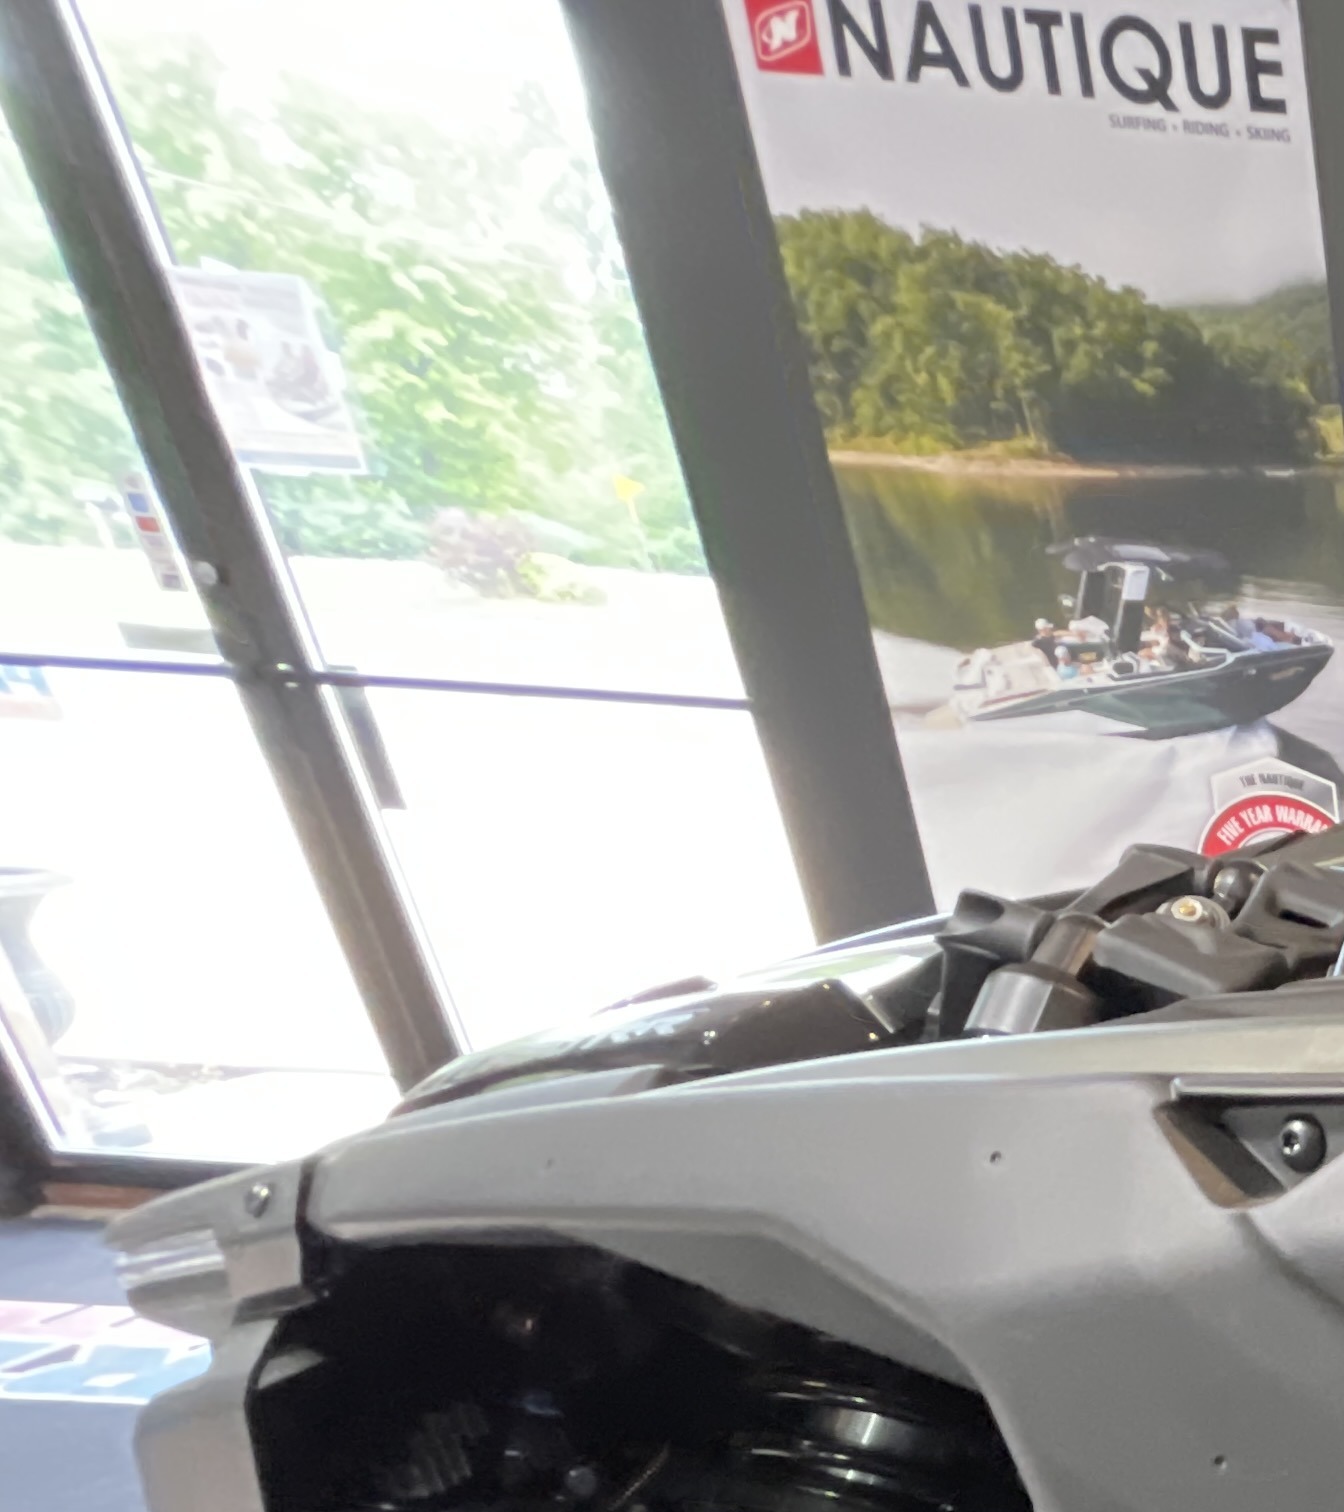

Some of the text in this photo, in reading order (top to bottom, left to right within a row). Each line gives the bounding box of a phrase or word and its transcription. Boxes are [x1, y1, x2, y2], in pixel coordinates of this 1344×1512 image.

[827, 0, 1288, 115] NAUTIQUE
[1108, 114, 1292, 143] SURFING RIDING SKIING
[1216, 815, 1246, 847] FIVE
[1238, 804, 1274, 829] YEAR
